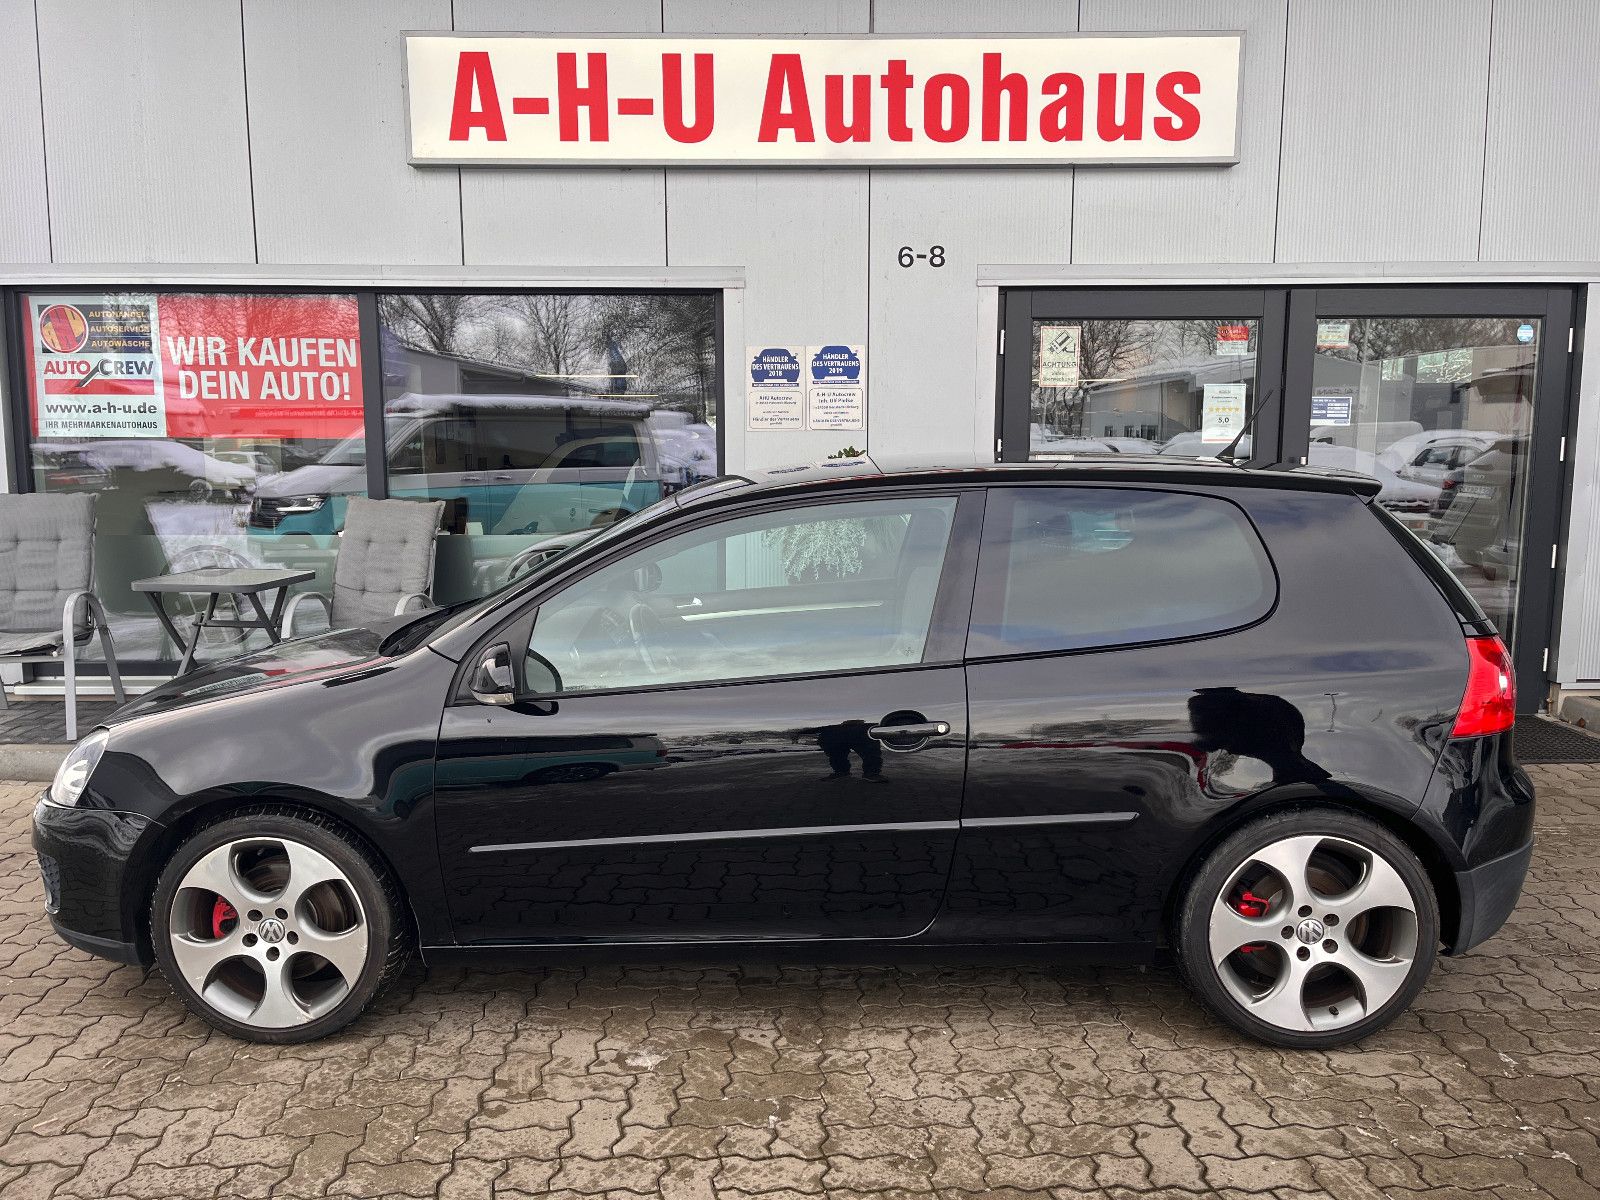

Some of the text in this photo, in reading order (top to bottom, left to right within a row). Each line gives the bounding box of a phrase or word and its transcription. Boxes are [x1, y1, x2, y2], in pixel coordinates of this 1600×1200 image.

[449, 51, 1201, 143] A-H-U Autohaus
[897, 246, 946, 268] 6-8
[166, 336, 357, 367] WIR KAUFEN
[822, 352, 849, 360] HÄNDLER
[763, 363, 799, 371] VERTRAUENS
[178, 370, 351, 401] DEIN AUTO!
[45, 402, 158, 414] www.a-h-u.de
[45, 421, 158, 429] IHR MEHRMARKENAUTOHAUS
